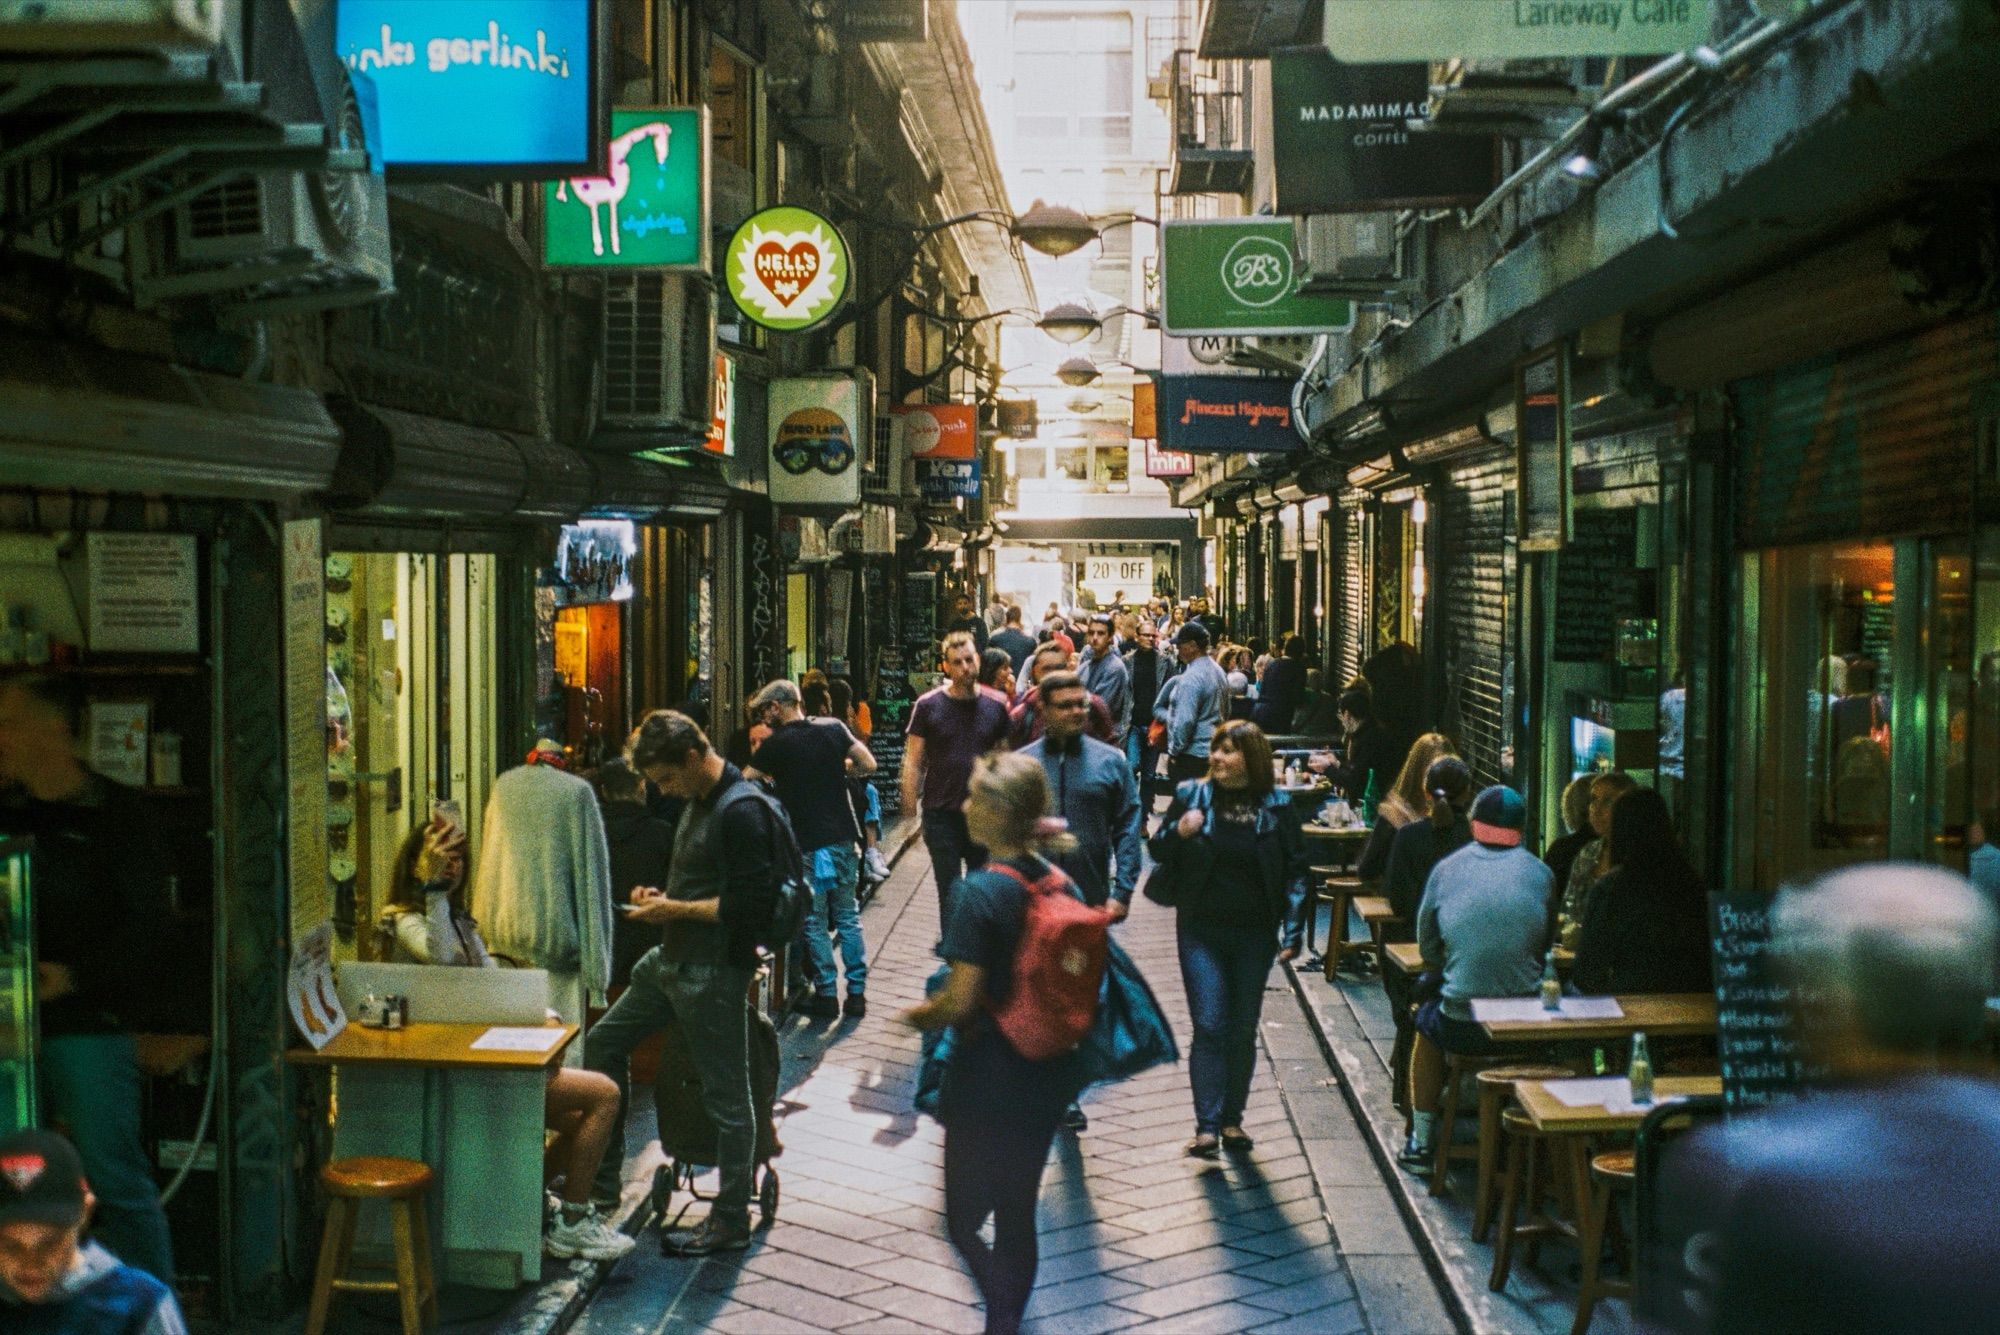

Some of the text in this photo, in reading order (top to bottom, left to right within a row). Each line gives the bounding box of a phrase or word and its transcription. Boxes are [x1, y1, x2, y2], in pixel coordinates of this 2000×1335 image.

[1514, 0, 1622, 33] Laneway
[342, 20, 569, 78] inki gerlinki
[1353, 130, 1409, 146] COFFEE
[757, 252, 817, 272] HELL'S
[1238, 400, 1290, 427] Highway
[1151, 450, 1190, 471] mini
[1121, 562, 1146, 580] OFF
